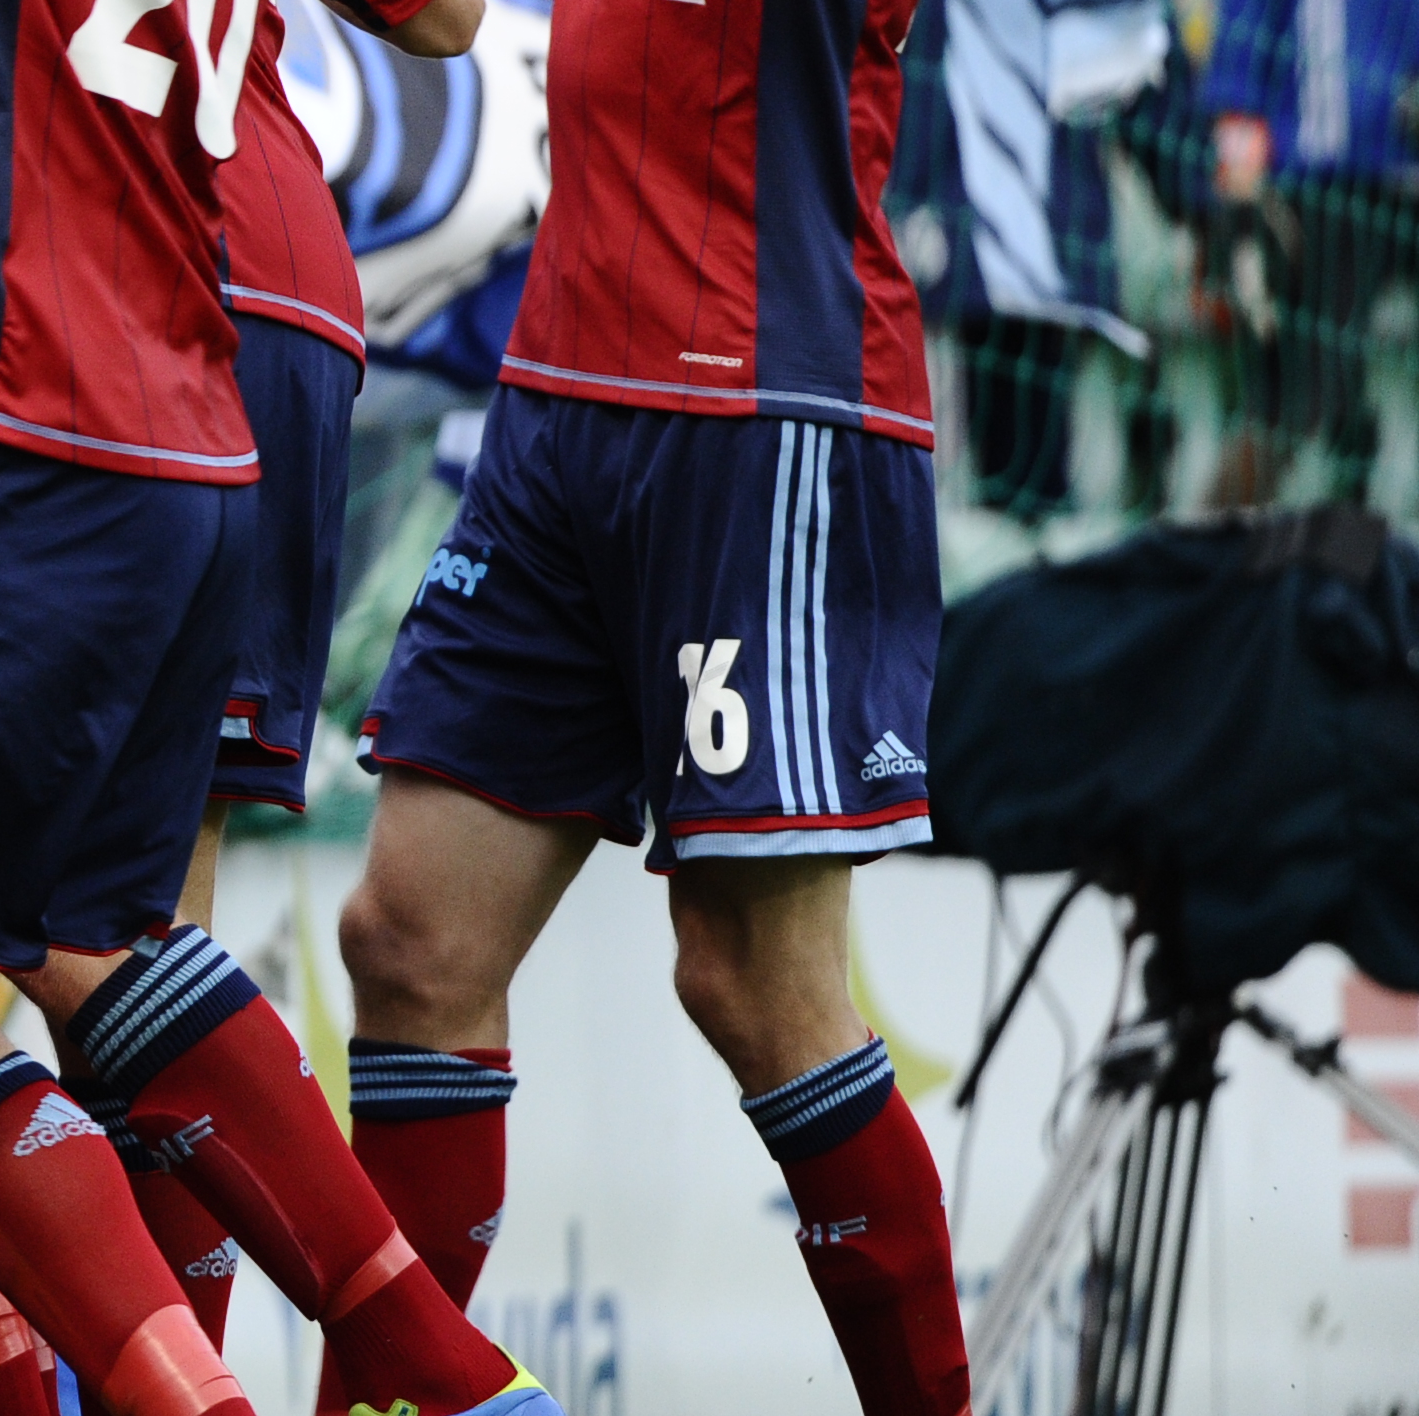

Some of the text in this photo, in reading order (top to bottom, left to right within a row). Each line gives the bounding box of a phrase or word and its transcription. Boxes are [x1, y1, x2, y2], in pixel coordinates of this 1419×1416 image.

[675, 638, 750, 777] 16
[860, 757, 928, 782] adidas
[149, 1114, 215, 1174] IF
